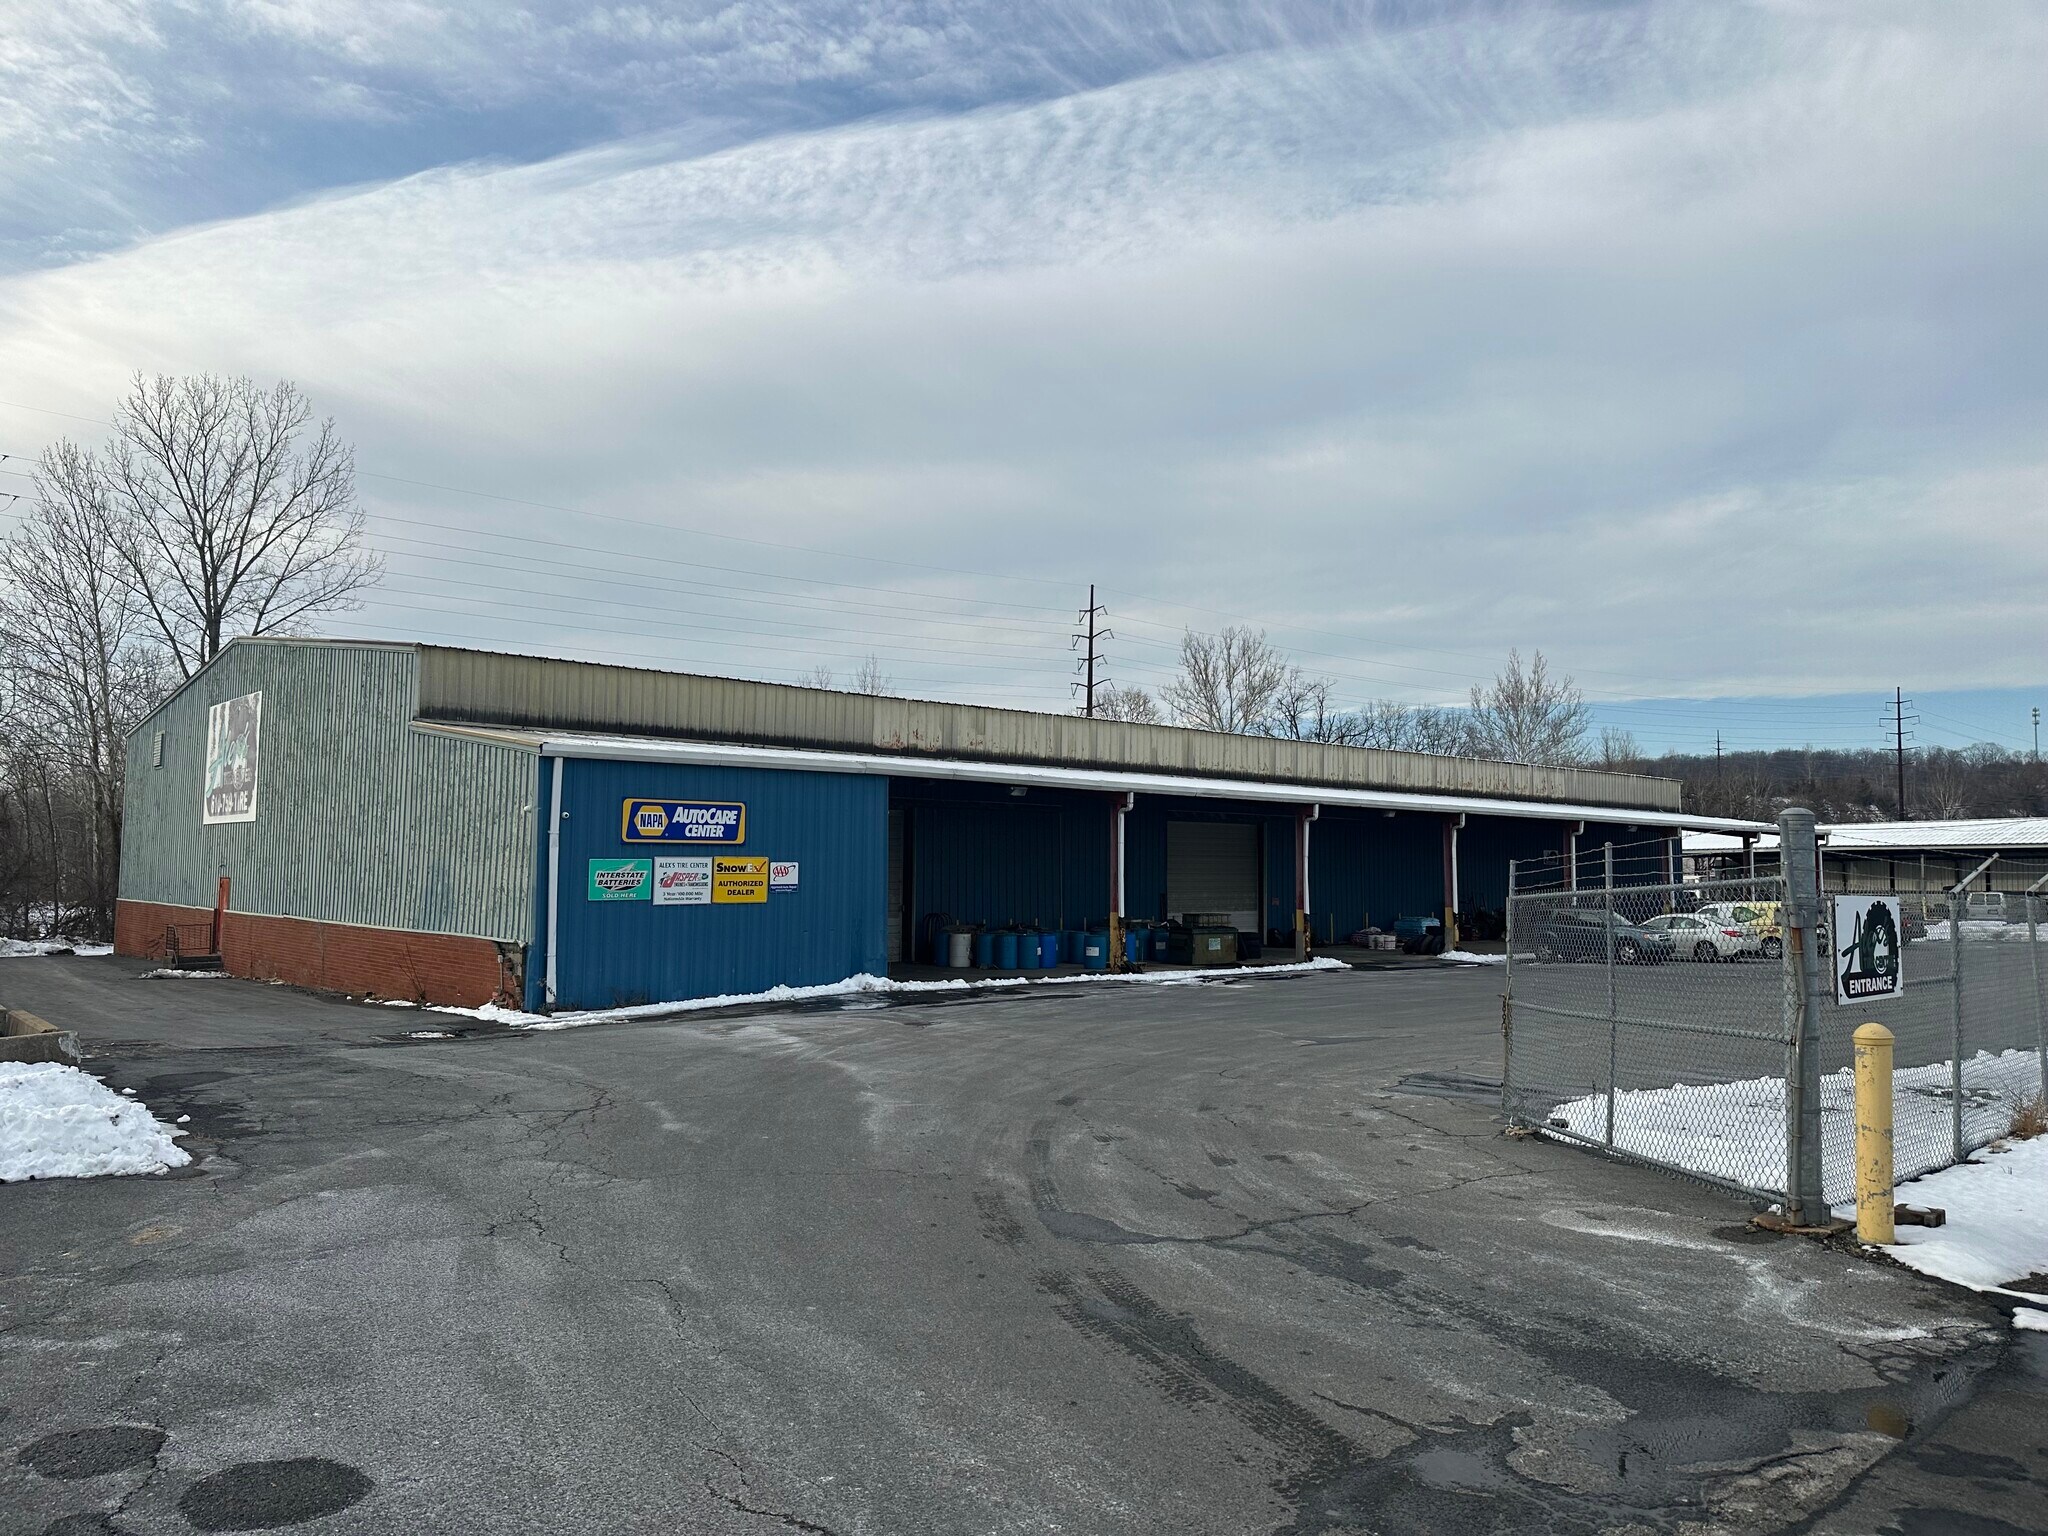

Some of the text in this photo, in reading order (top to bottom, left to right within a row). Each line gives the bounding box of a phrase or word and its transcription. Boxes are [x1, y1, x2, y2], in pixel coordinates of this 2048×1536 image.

[639, 813, 664, 828] NAPA
[684, 824, 725, 838] CENTER
[663, 872, 699, 888] JASPER
[1849, 975, 1893, 995] ENTRANCE
